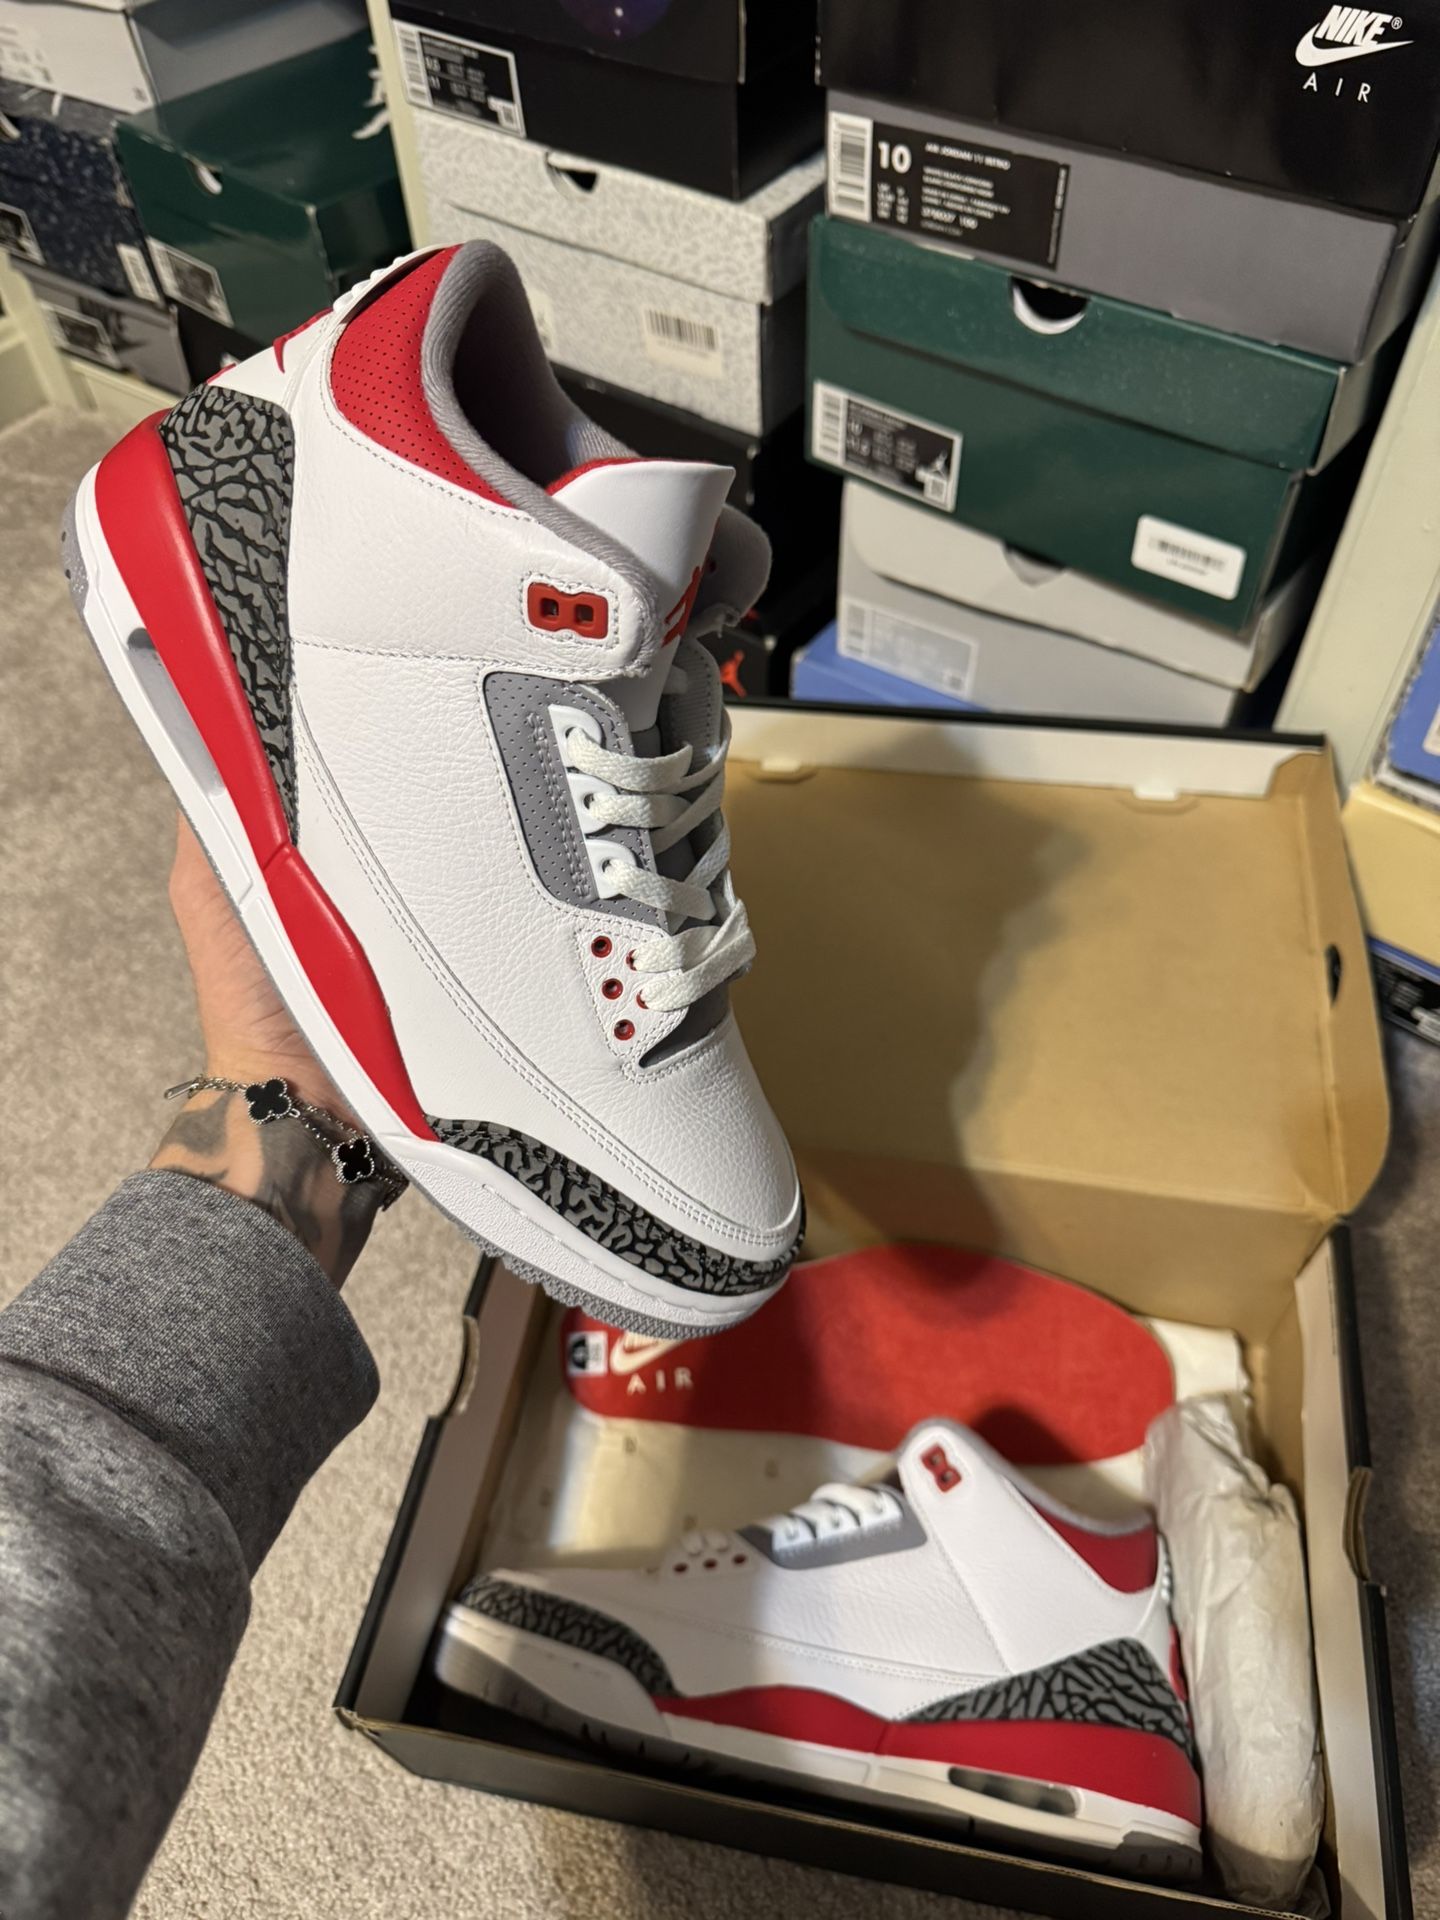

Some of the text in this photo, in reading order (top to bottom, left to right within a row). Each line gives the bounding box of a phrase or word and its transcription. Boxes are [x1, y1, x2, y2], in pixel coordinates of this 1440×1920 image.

[1302, 72, 1371, 103] AIR
[879, 141, 911, 174] 10
[627, 1367, 693, 1396] AIR
